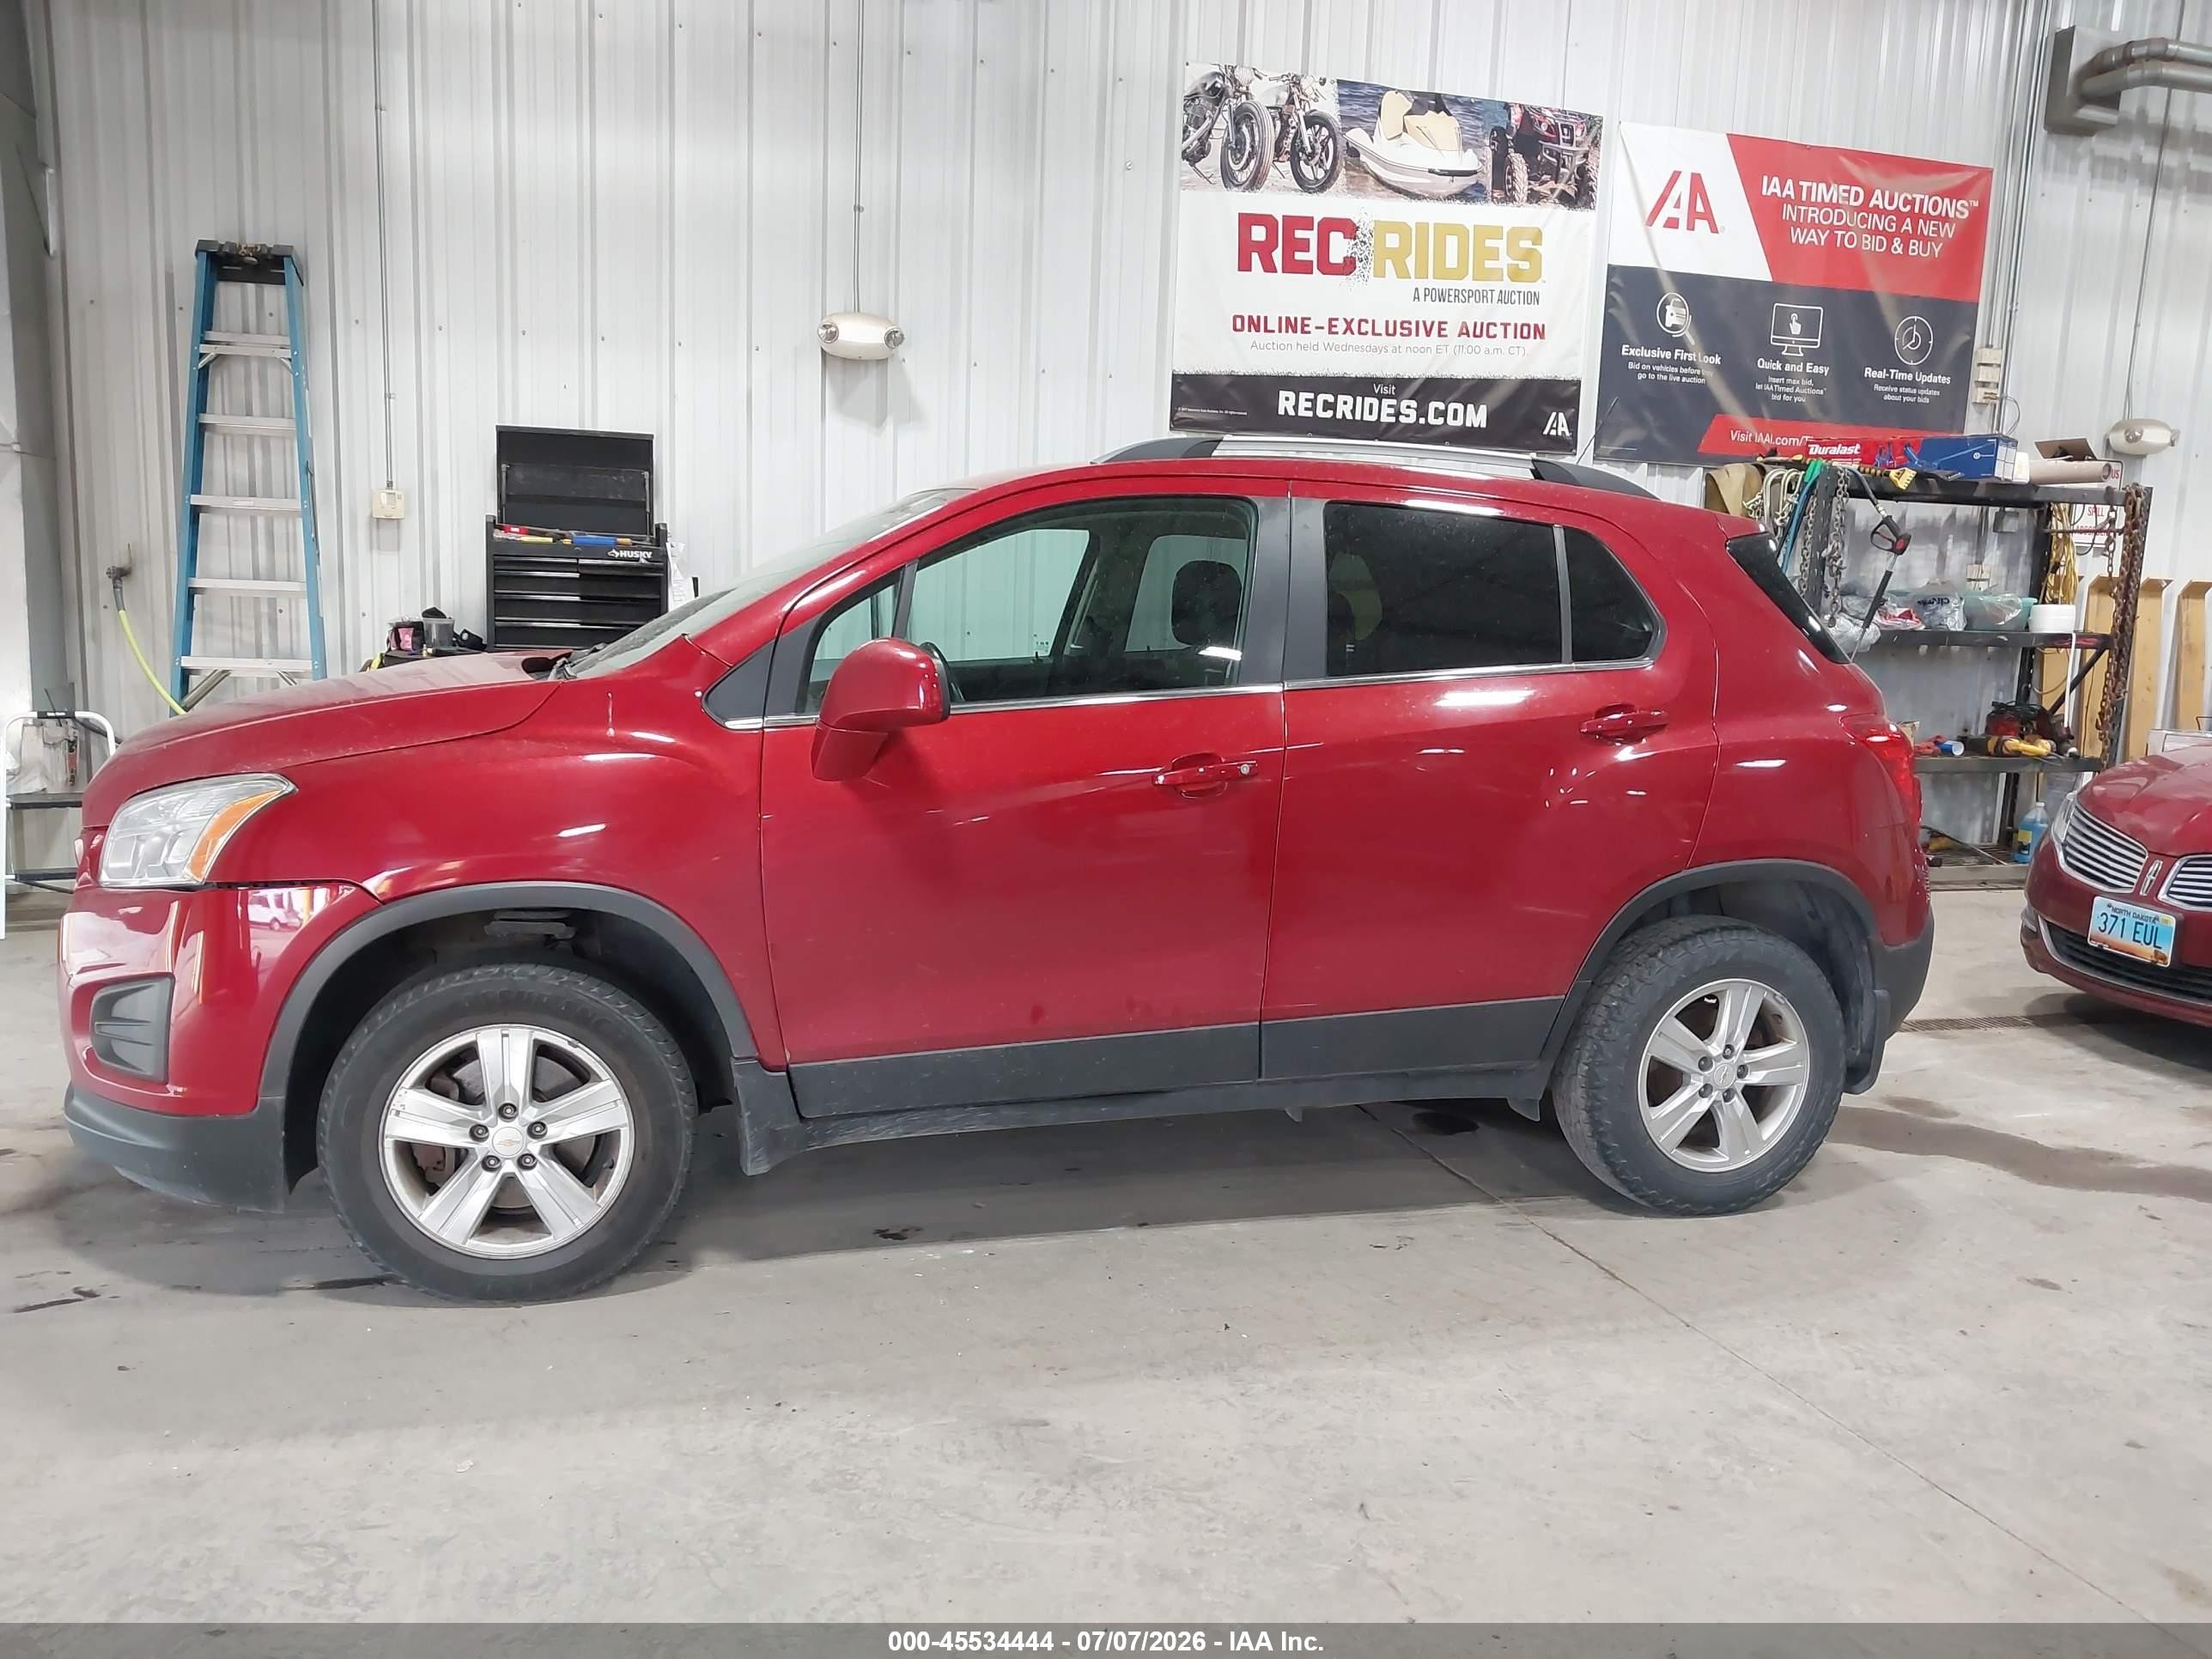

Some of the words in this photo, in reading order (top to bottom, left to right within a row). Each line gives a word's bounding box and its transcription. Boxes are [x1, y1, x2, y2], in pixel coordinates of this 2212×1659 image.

[1761, 175, 1796, 199] IAA
[1799, 181, 1865, 207] TIMED
[1782, 204, 1897, 233] INTRODUCING
[1900, 220, 1912, 234] A
[1917, 219, 1956, 238] NEW
[1790, 227, 1830, 246] WAY
[1834, 231, 1857, 248] TO
[1862, 234, 1887, 252] BID
[1891, 237, 1903, 255] &
[1908, 240, 1943, 258] BUY
[1413, 288, 1420, 302] A
[1424, 288, 1495, 305] POWERSPORT
[1498, 289, 1540, 306] AUCTION
[1232, 315, 1449, 338] ONLINE-EXCLUSIVE
[1457, 321, 1547, 340] AUCTION
[1250, 341, 1293, 351] Auction
[1296, 341, 1320, 352] held
[1322, 342, 1389, 355] Wednesdays
[1391, 344, 1402, 355] at
[1405, 345, 1432, 356] noon
[1435, 345, 1449, 355] ET
[1621, 344, 1672, 359] Exclusive
[1674, 349, 1697, 362] First
[1698, 352, 1722, 365] Look
[1652, 364, 1678, 374] vehicles
[1680, 366, 1701, 375] before
[1757, 358, 1783, 371] Quick
[1784, 362, 1803, 372] and
[1806, 362, 1830, 377] Easy
[1637, 372, 1647, 380] go
[1668, 374, 1680, 382] live
[1681, 375, 1706, 385] auction
[1767, 375, 1785, 384] Insert
[1802, 378, 1814, 386] bid,
[1863, 367, 1913, 380] Real-Time
[1915, 371, 1952, 385] Updates
[1372, 383, 1396, 395] Visit
[1774, 385, 1795, 393] Timed
[1874, 383, 1899, 392] Receive
[1793, 395, 1807, 404] you
[1278, 390, 1488, 428] RECRIDES.COM
[1730, 429, 1753, 442] Visit
[1808, 443, 1861, 455] Duralast
[619, 550, 653, 558] HUSKY
[2111, 906, 2131, 917] NORTH
[2132, 912, 2157, 925] DAKOTA
[2098, 912, 2126, 939] 371
[2132, 921, 2162, 950] EUL
